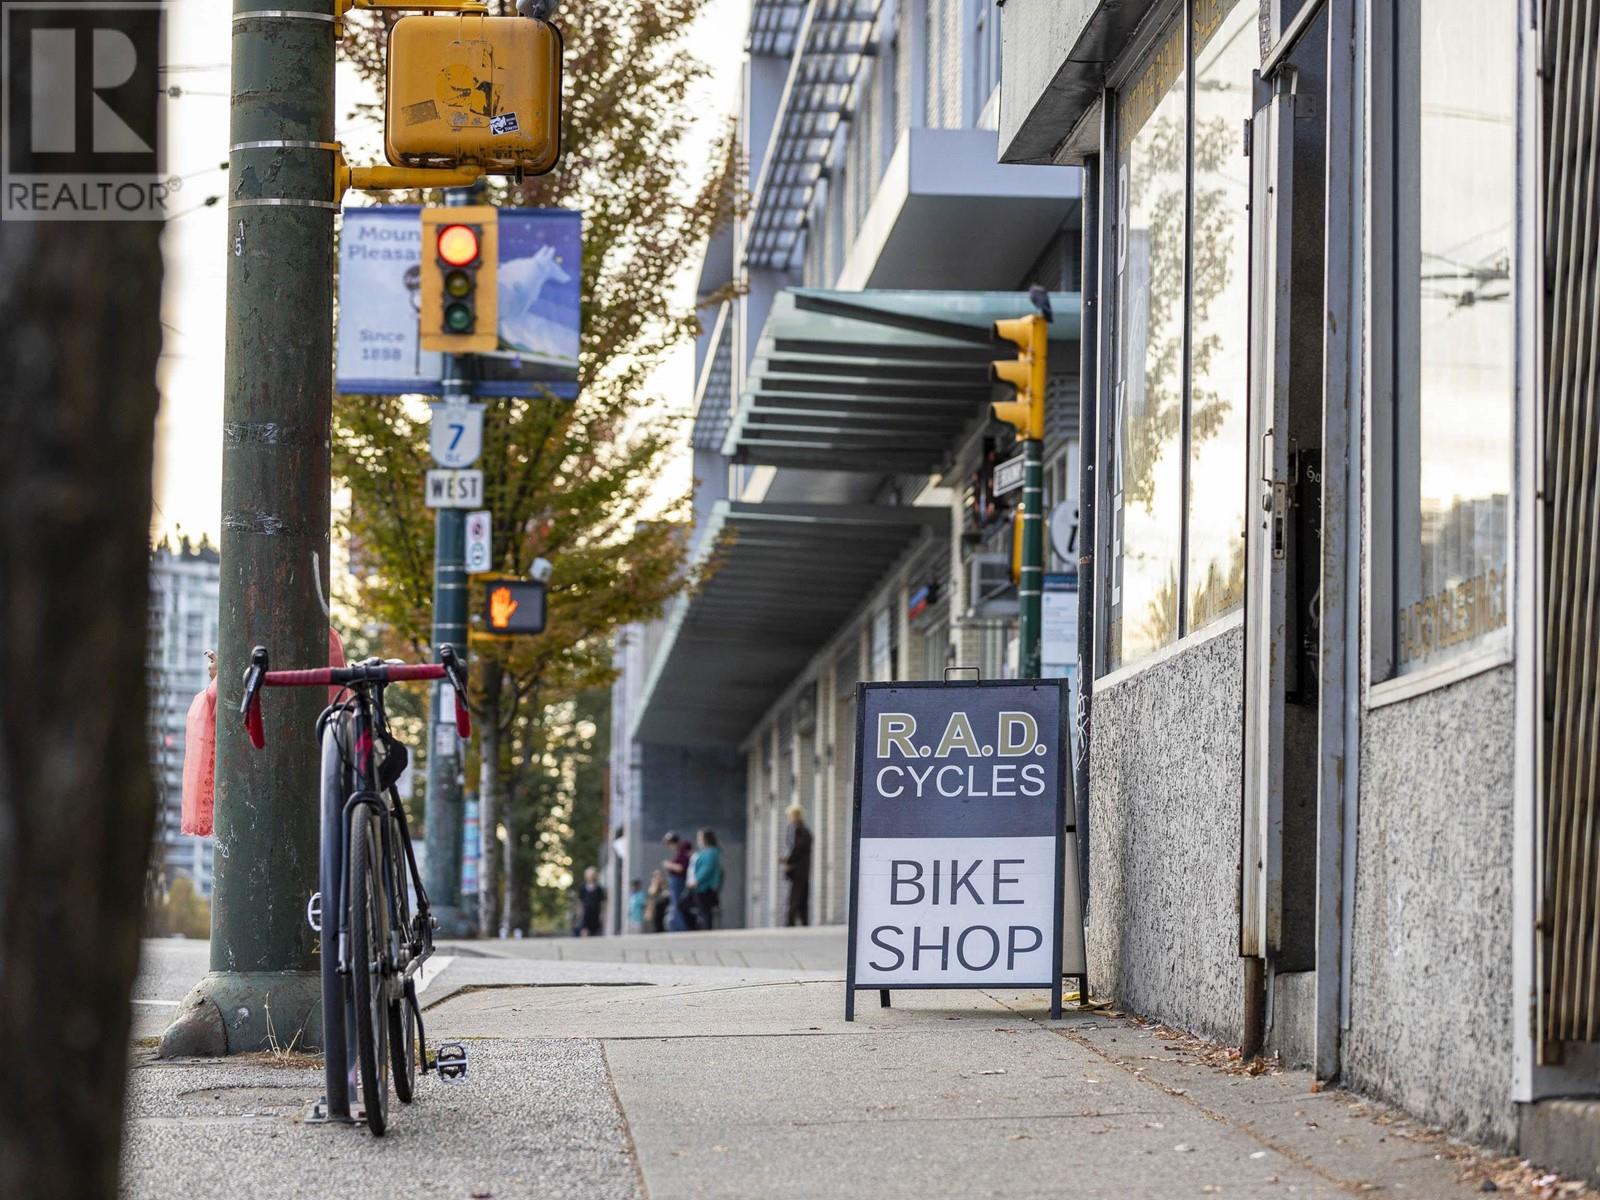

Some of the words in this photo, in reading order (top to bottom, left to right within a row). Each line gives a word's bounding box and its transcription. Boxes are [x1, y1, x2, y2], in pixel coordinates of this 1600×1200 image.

[358, 226, 421, 241] Moun
[348, 244, 421, 260] Pleasa
[360, 329, 405, 343] Since
[448, 423, 465, 451] 7
[431, 476, 478, 499] WEST
[876, 711, 1047, 759] R.A.D.
[876, 764, 1046, 798] CYCLES
[890, 858, 1025, 906] BIKE
[868, 925, 1043, 972] SHOP
